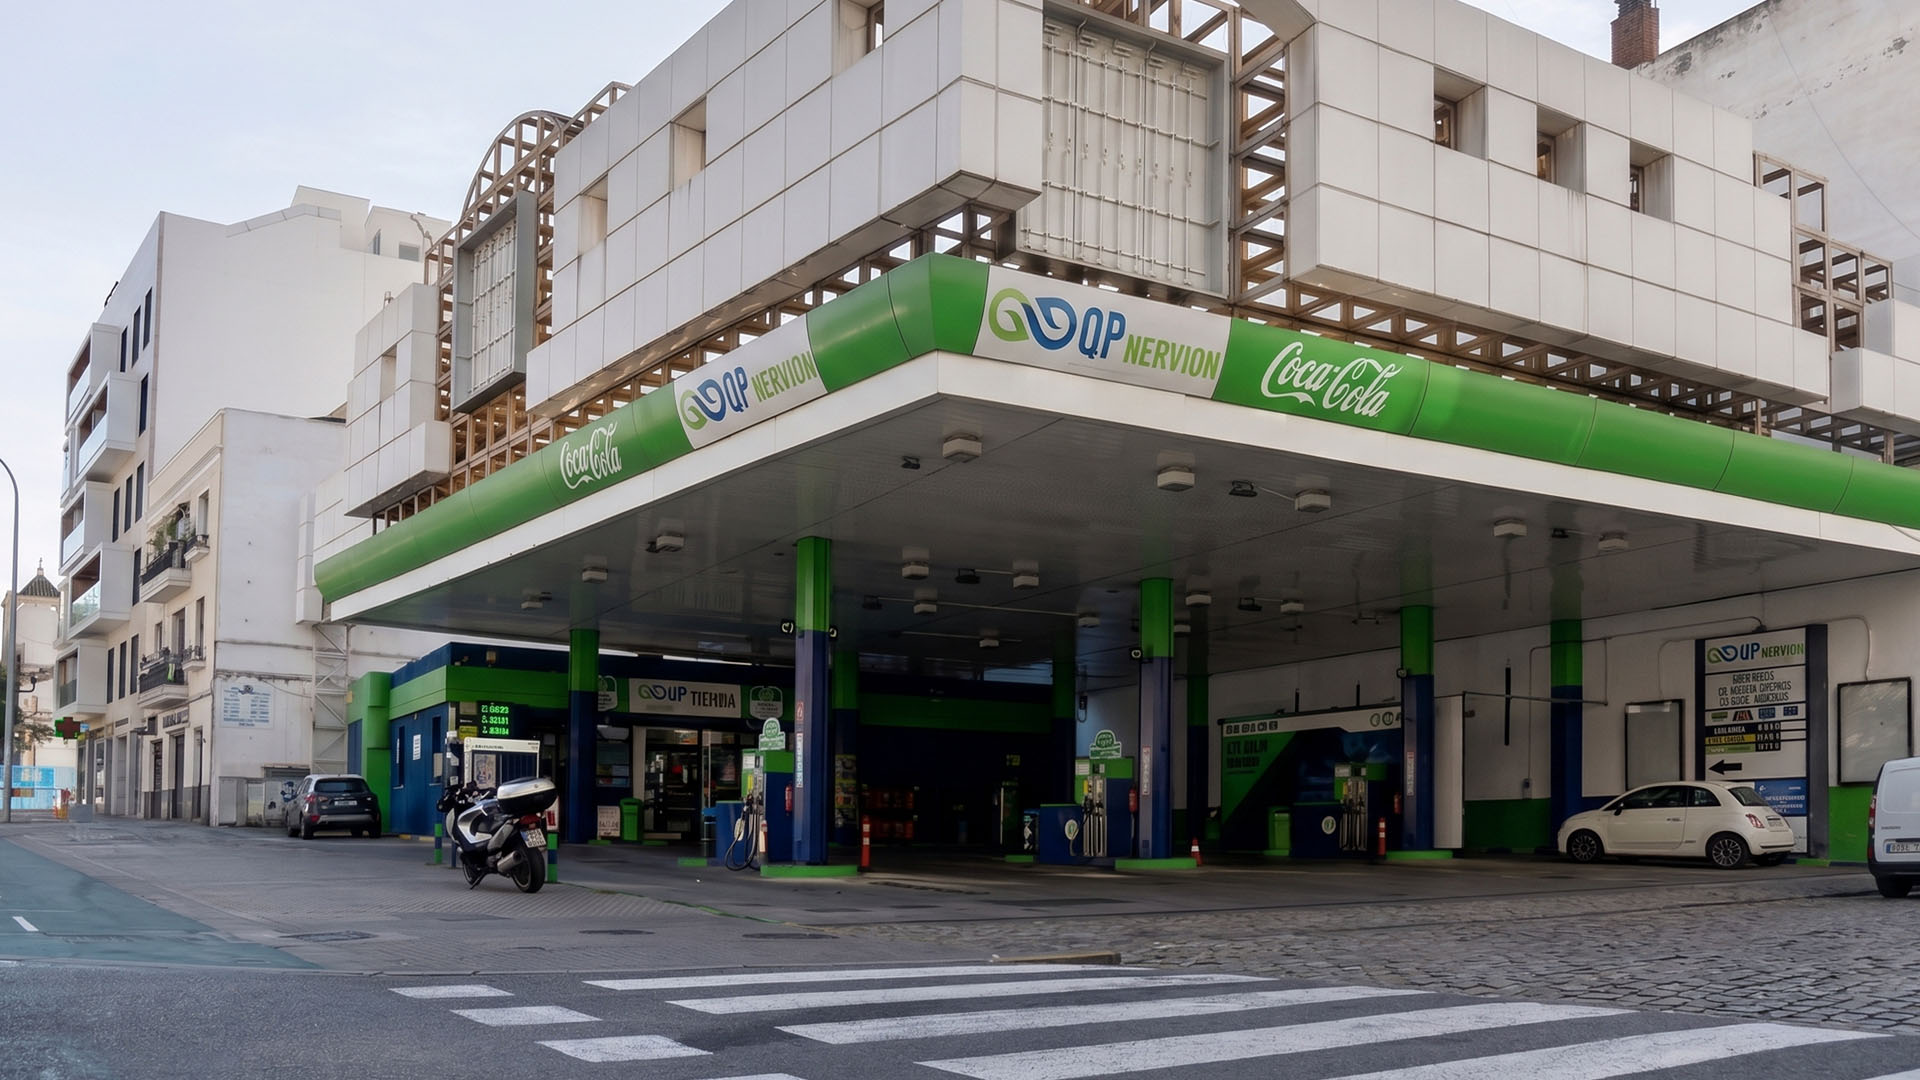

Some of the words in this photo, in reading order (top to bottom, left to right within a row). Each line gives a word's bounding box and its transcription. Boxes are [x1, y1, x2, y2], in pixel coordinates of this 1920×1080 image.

[751, 350, 817, 403] NERVION
[1122, 333, 1221, 380] NERVION
[1761, 642, 1804, 659] NERVION
